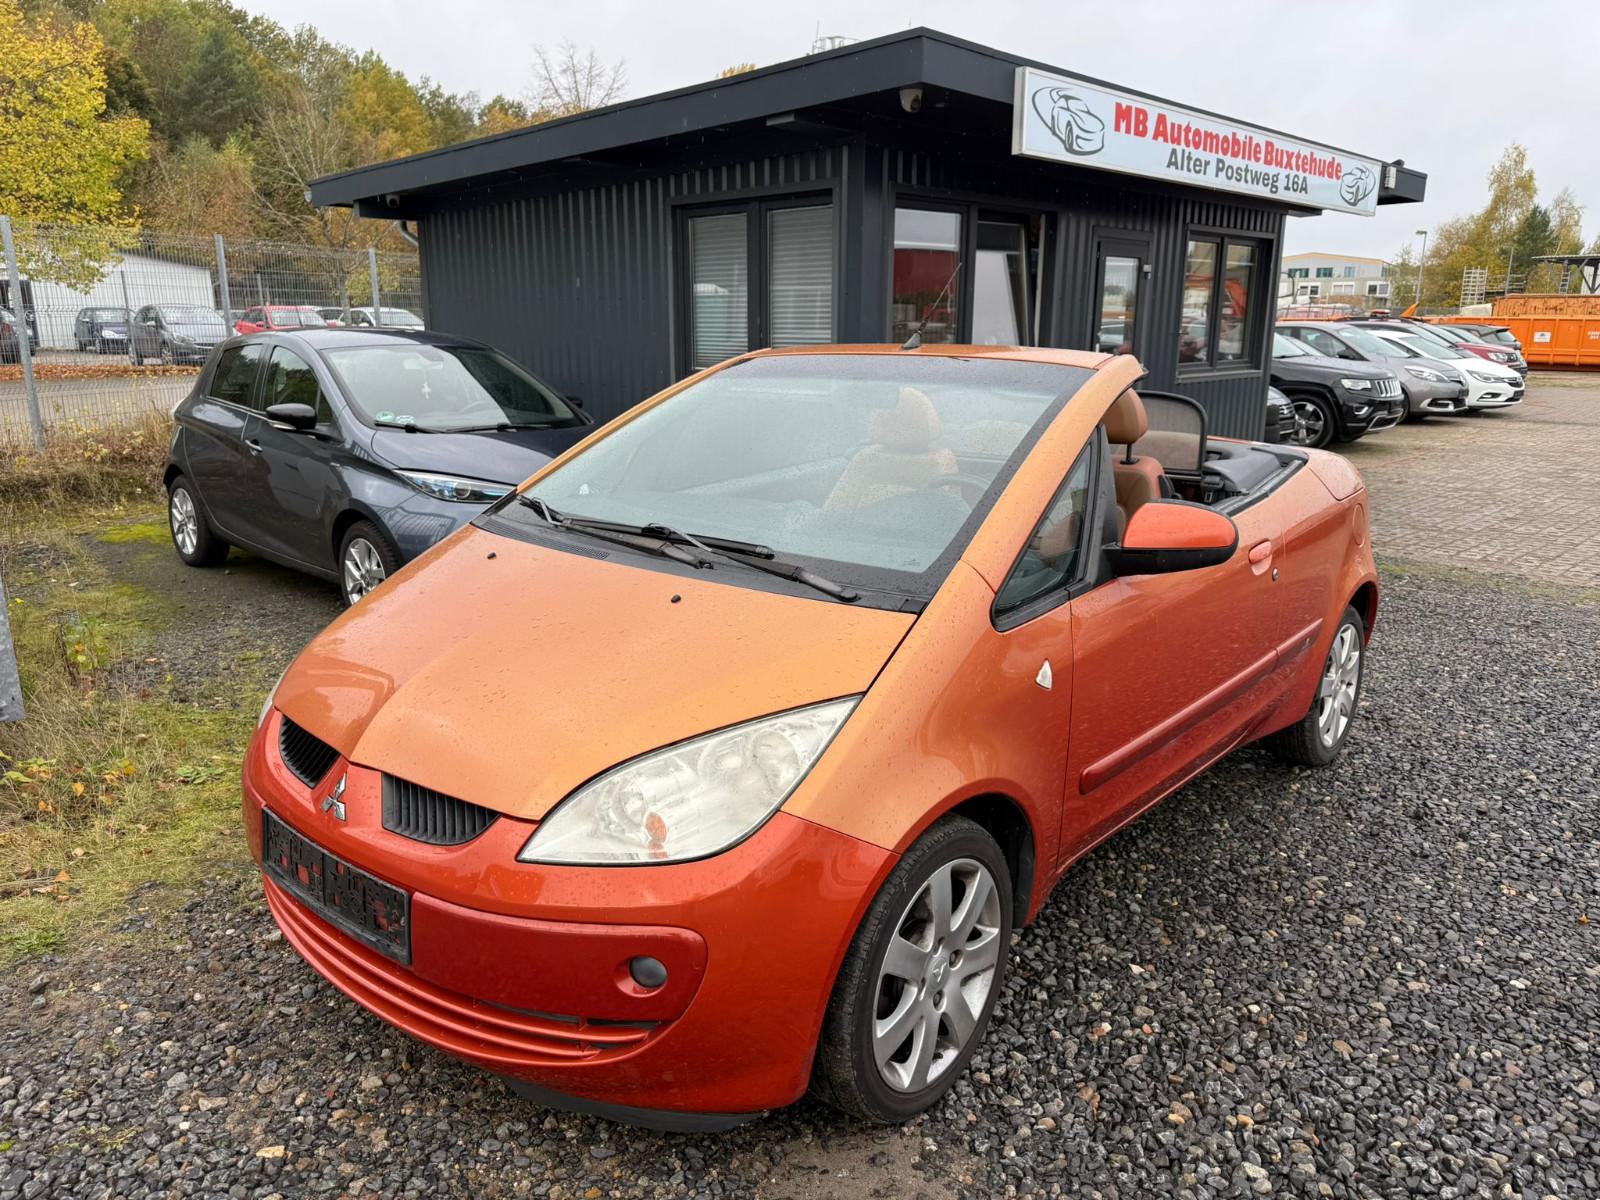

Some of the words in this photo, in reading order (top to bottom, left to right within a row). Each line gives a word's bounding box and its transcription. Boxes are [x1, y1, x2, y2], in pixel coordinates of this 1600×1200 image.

[1114, 102, 1148, 138] MB
[1152, 112, 1262, 163] Automobile
[1263, 140, 1343, 181] Buxtehude
[1166, 148, 1211, 176] Alter
[1215, 158, 1280, 194] Postweg
[1284, 173, 1308, 194] 16A
